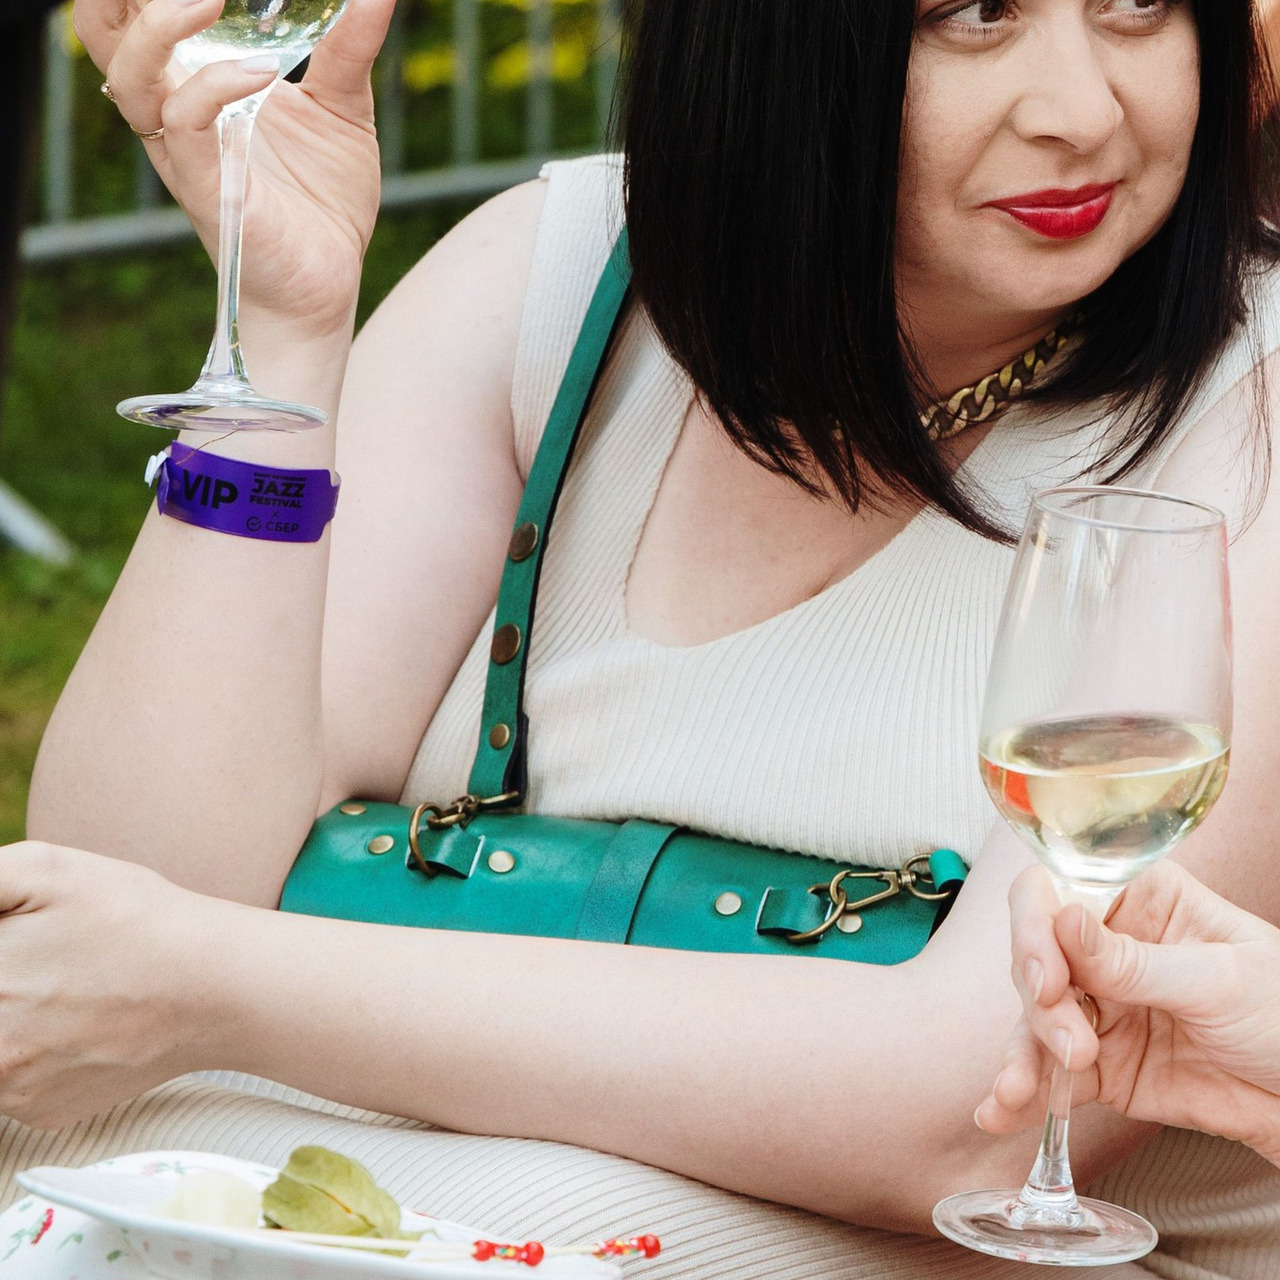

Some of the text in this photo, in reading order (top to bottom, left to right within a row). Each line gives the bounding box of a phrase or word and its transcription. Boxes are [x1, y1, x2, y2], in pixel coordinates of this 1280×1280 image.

[183, 469, 239, 509] VIP
[251, 478, 306, 498] JAZZ
[250, 494, 302, 508] FESTIVAL
[265, 520, 300, 533] СБЕР
